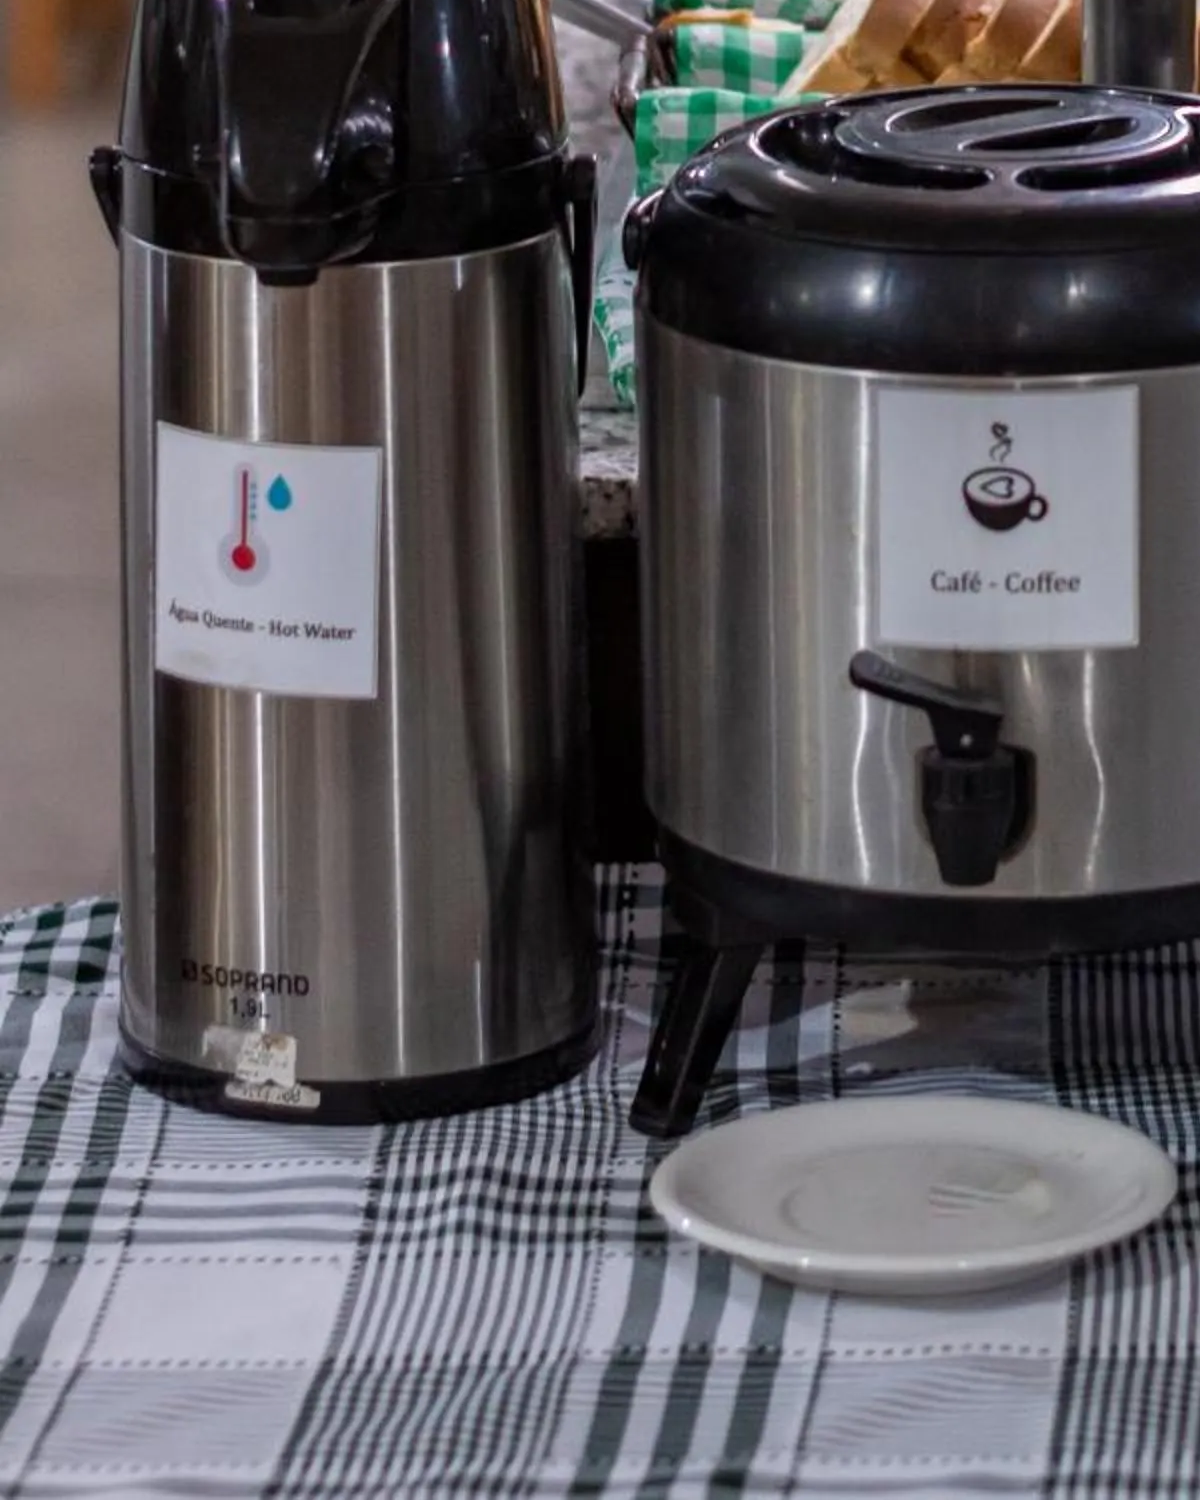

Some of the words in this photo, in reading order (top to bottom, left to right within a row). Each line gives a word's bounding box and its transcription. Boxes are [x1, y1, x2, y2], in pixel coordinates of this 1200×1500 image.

[930, 569, 982, 594] Café
[1005, 570, 1081, 594] Coffee
[203, 609, 254, 633] Quente
[269, 619, 299, 638] Hot
[305, 623, 356, 640] Water
